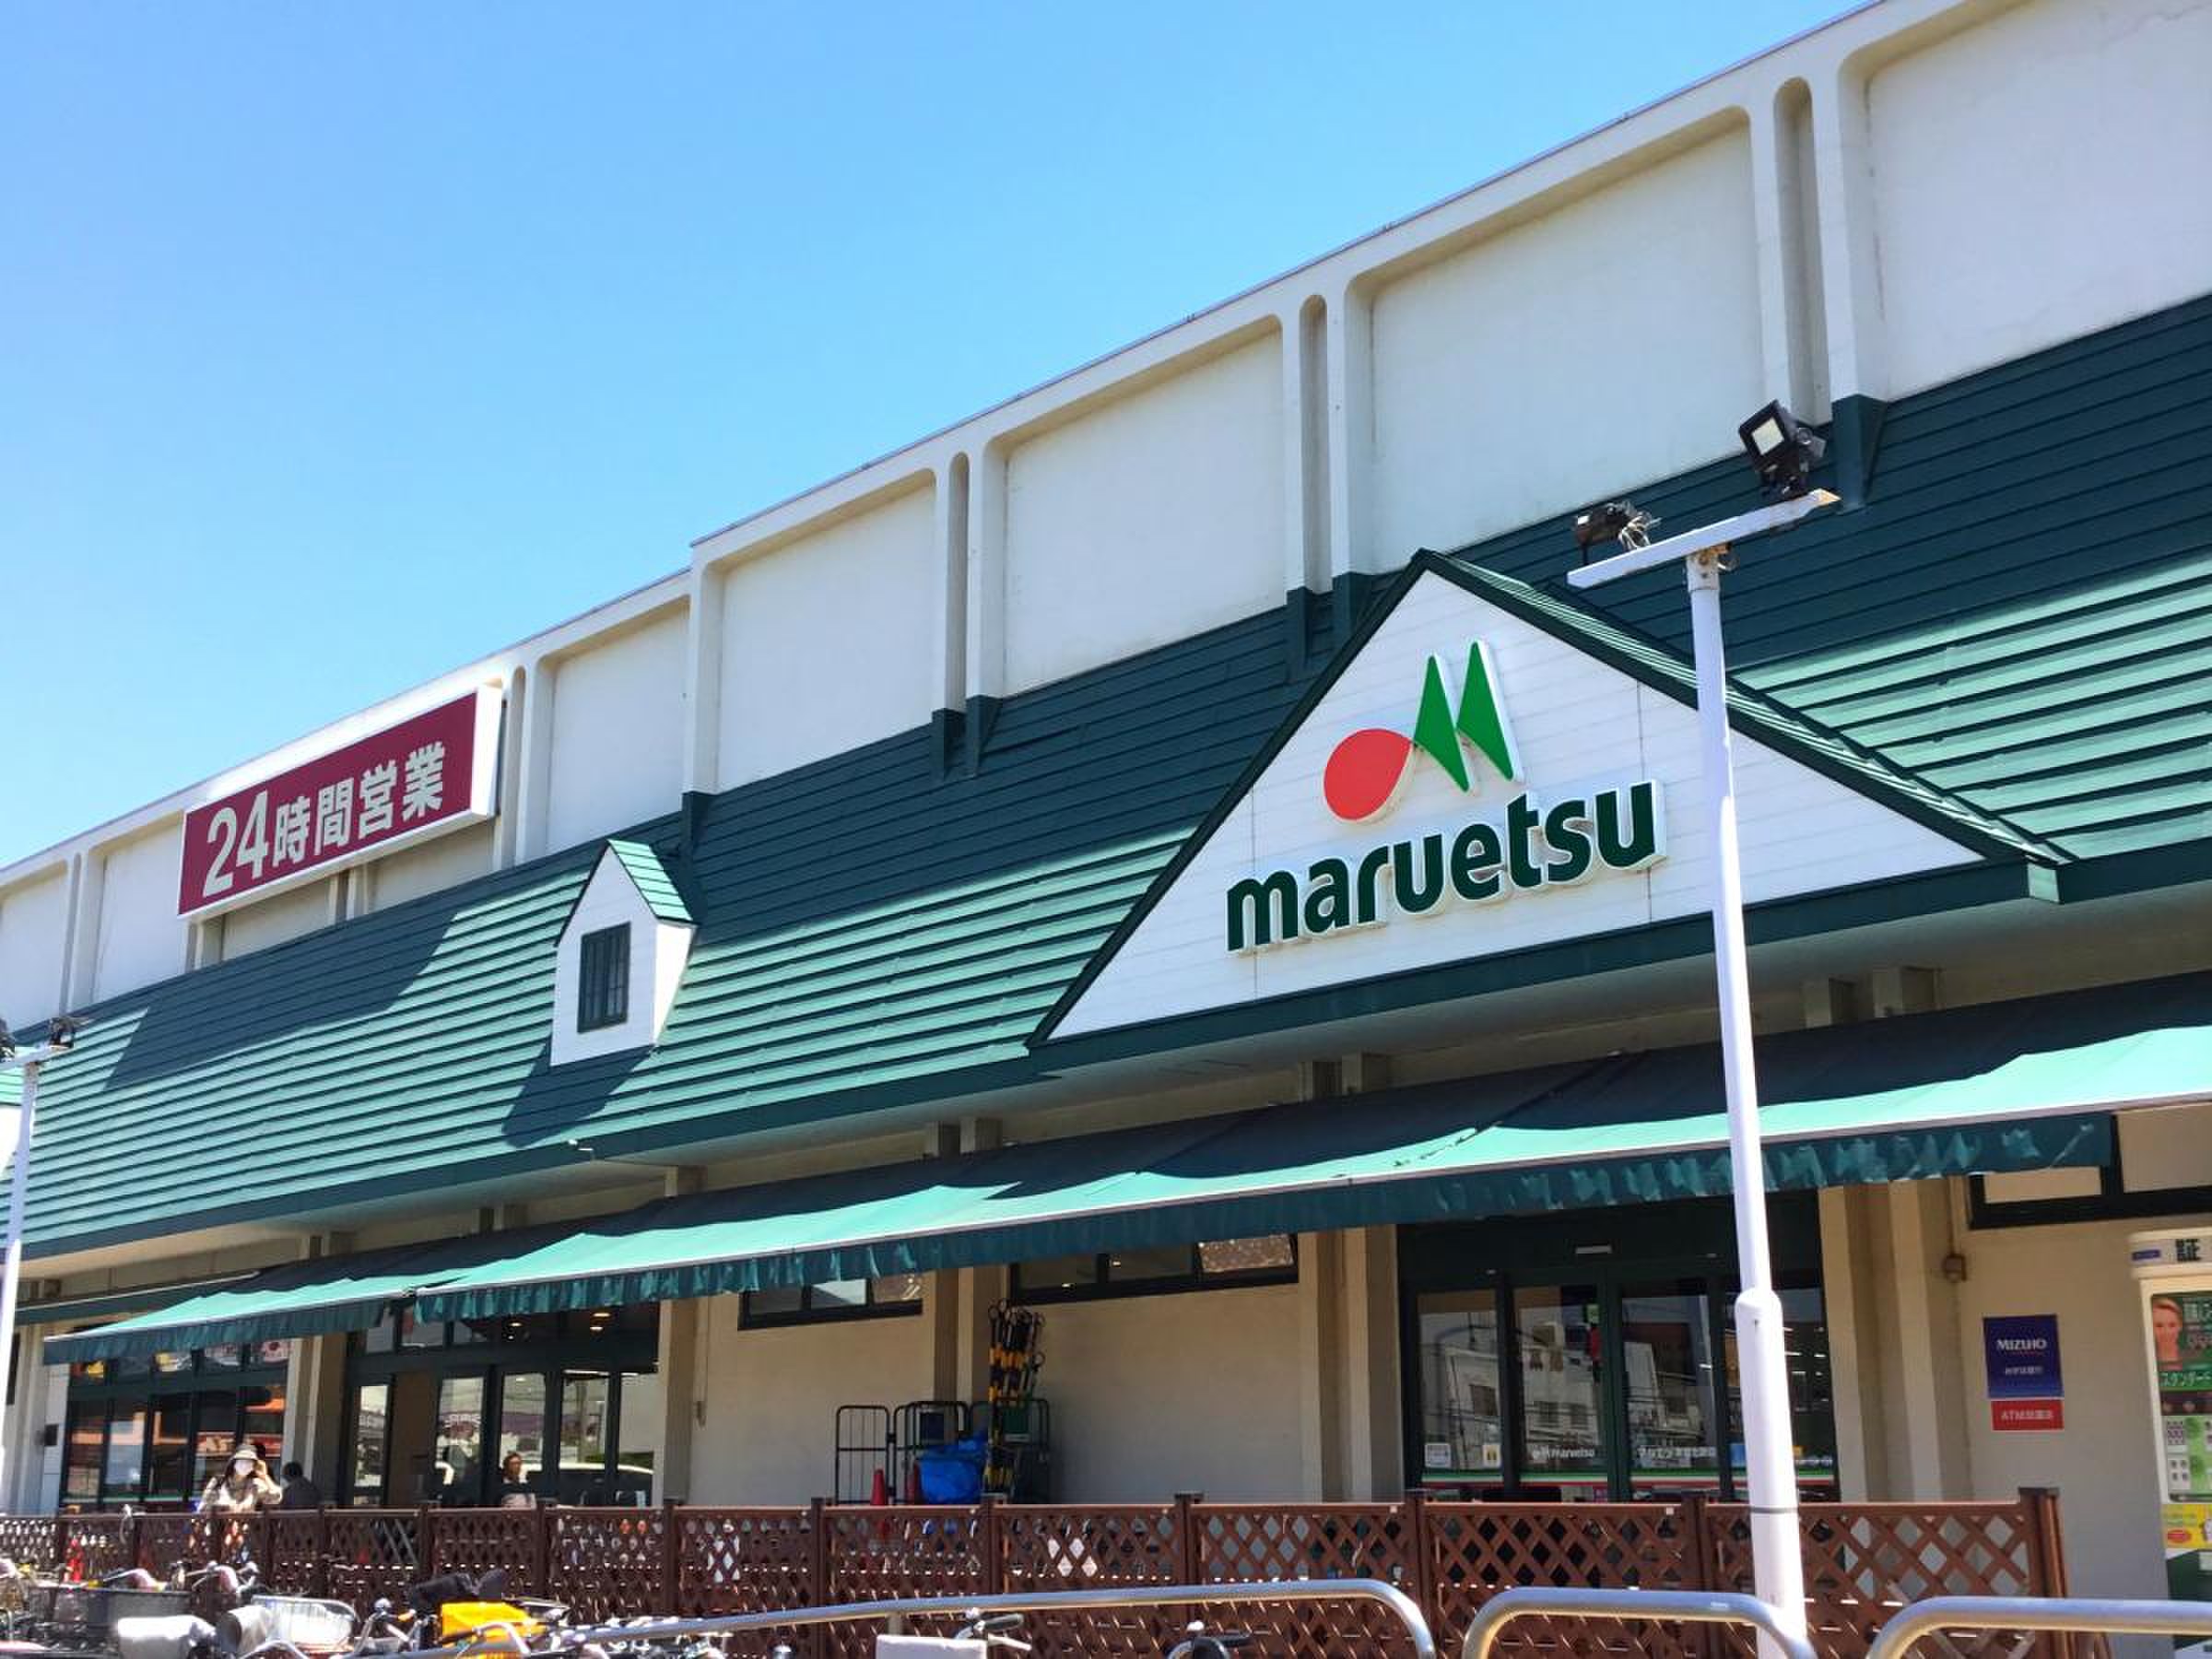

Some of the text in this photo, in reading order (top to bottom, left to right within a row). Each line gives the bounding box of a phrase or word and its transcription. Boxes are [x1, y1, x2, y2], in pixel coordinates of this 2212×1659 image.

[202, 741, 446, 899] 24時間営業
[1227, 782, 1659, 952] maruetsu
[1996, 1338, 2048, 1351] MIZUHO
